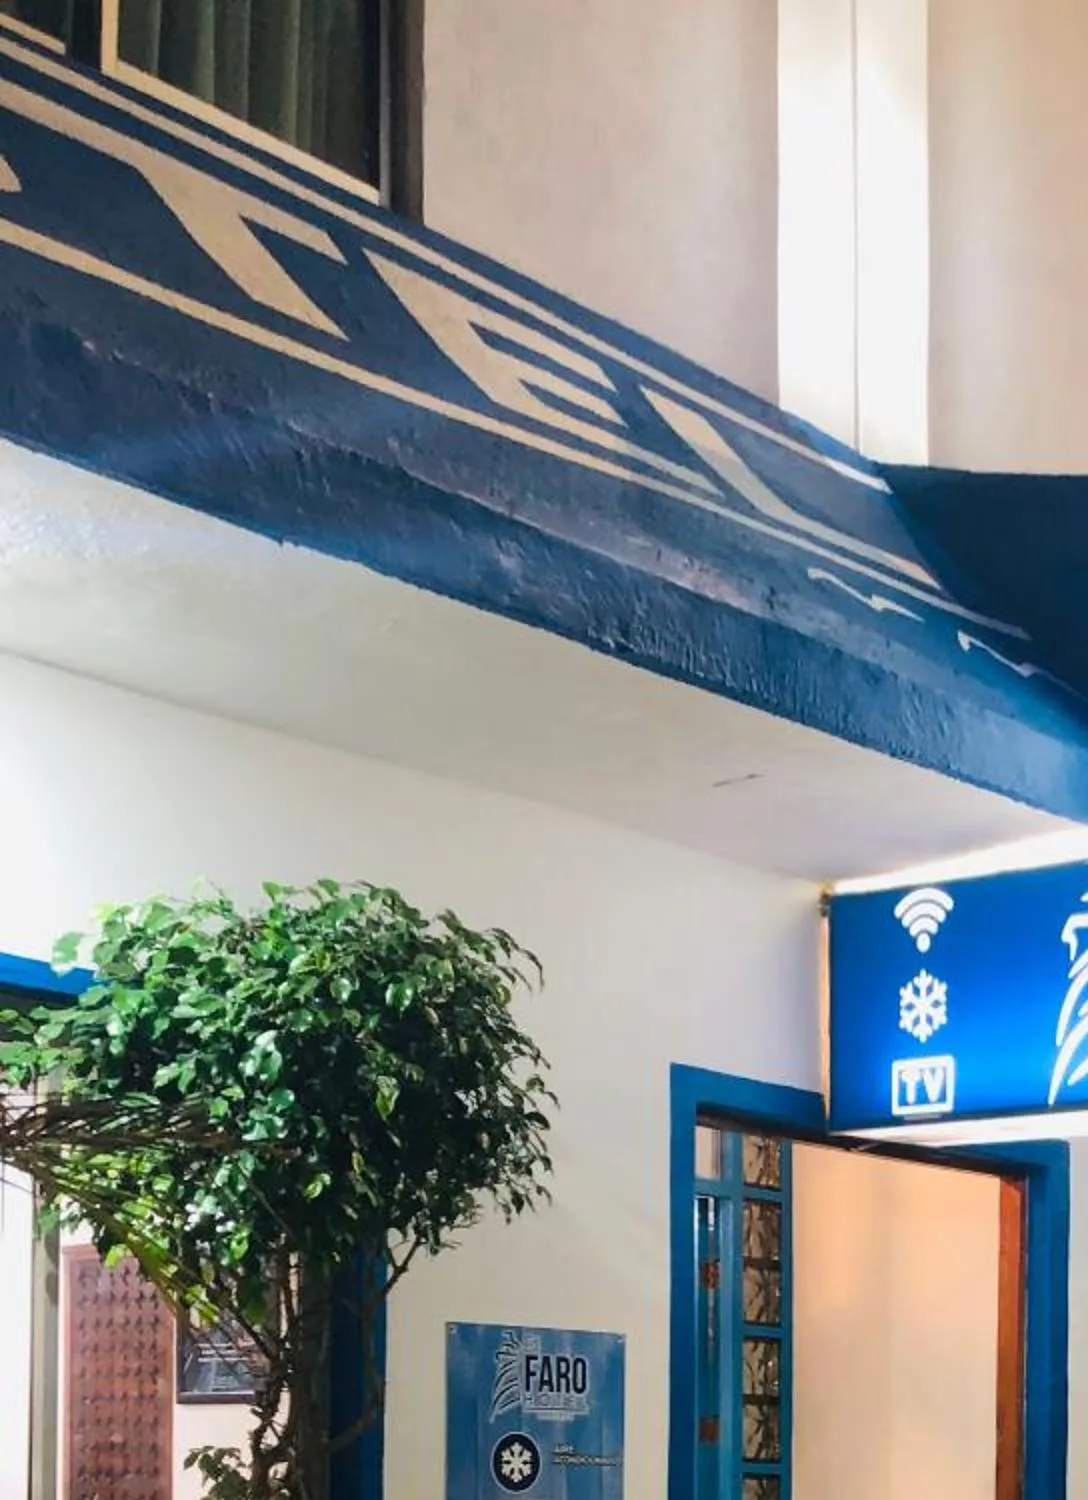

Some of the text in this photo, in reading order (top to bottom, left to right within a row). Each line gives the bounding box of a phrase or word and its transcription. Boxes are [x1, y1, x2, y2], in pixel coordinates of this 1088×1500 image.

[0, 78, 943, 590] TEL
[901, 1068, 944, 1104] TV
[525, 1355, 587, 1394] FARO
